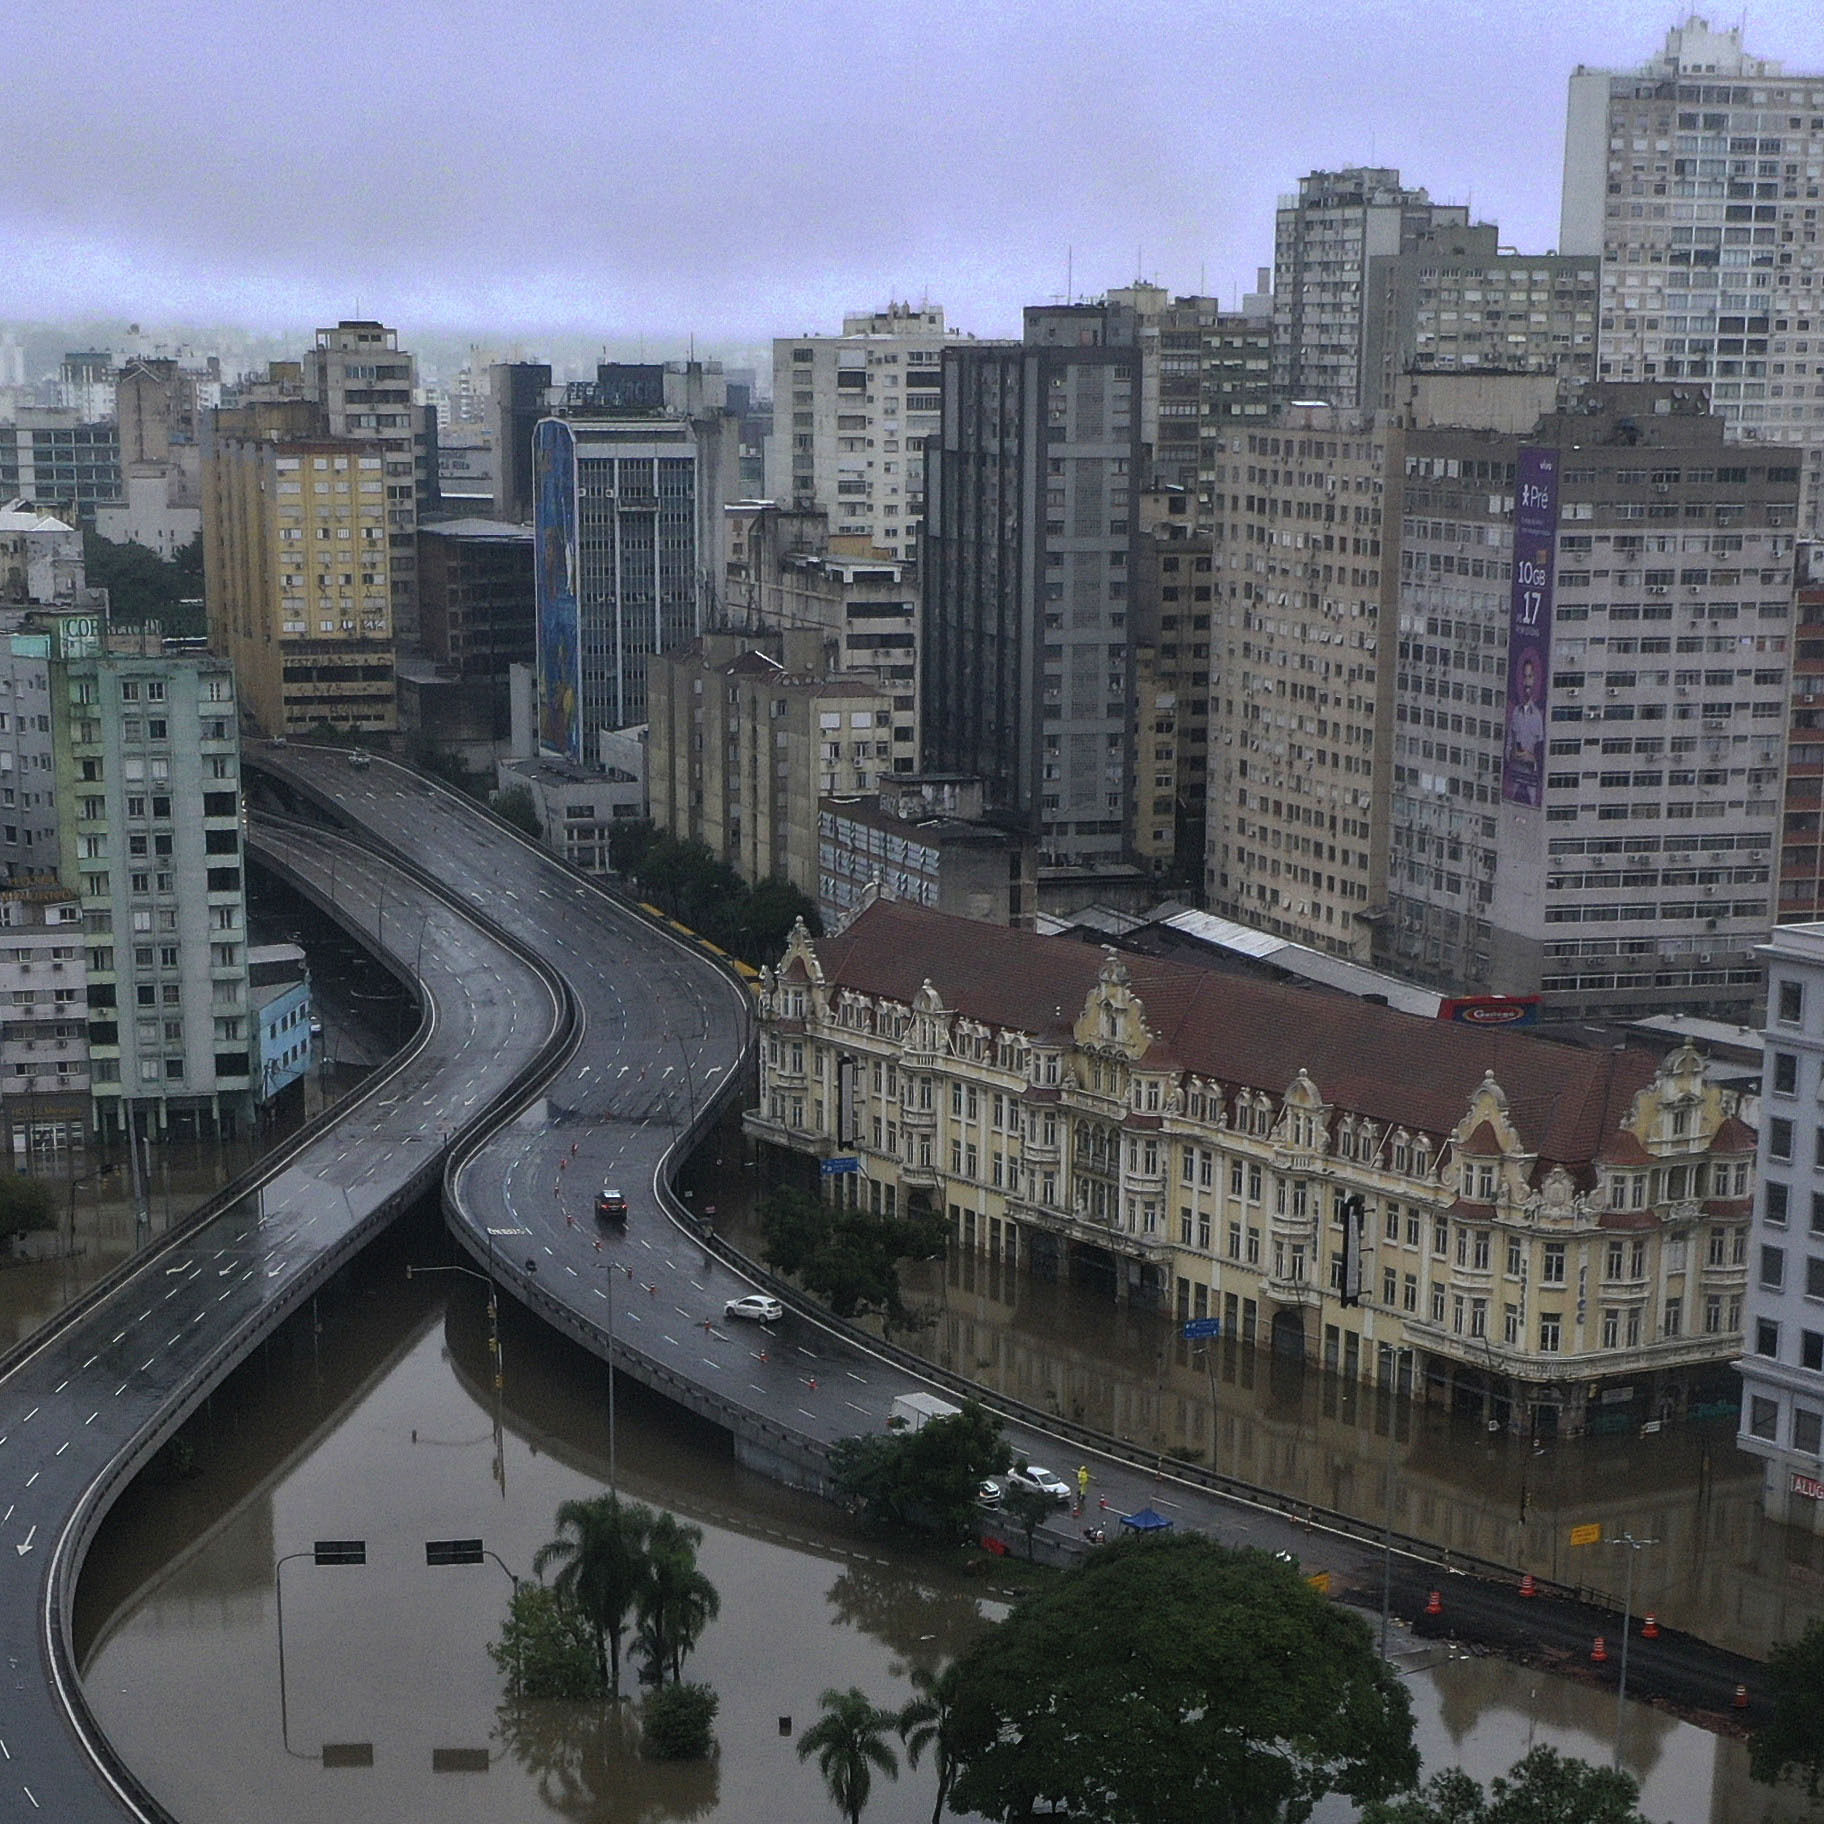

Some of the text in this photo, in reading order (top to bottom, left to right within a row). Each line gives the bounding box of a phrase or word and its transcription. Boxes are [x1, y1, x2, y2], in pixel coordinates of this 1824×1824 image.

[1530, 485, 1549, 510] Pré
[1517, 561, 1546, 586] 10GB
[1523, 591, 1542, 625] 17
